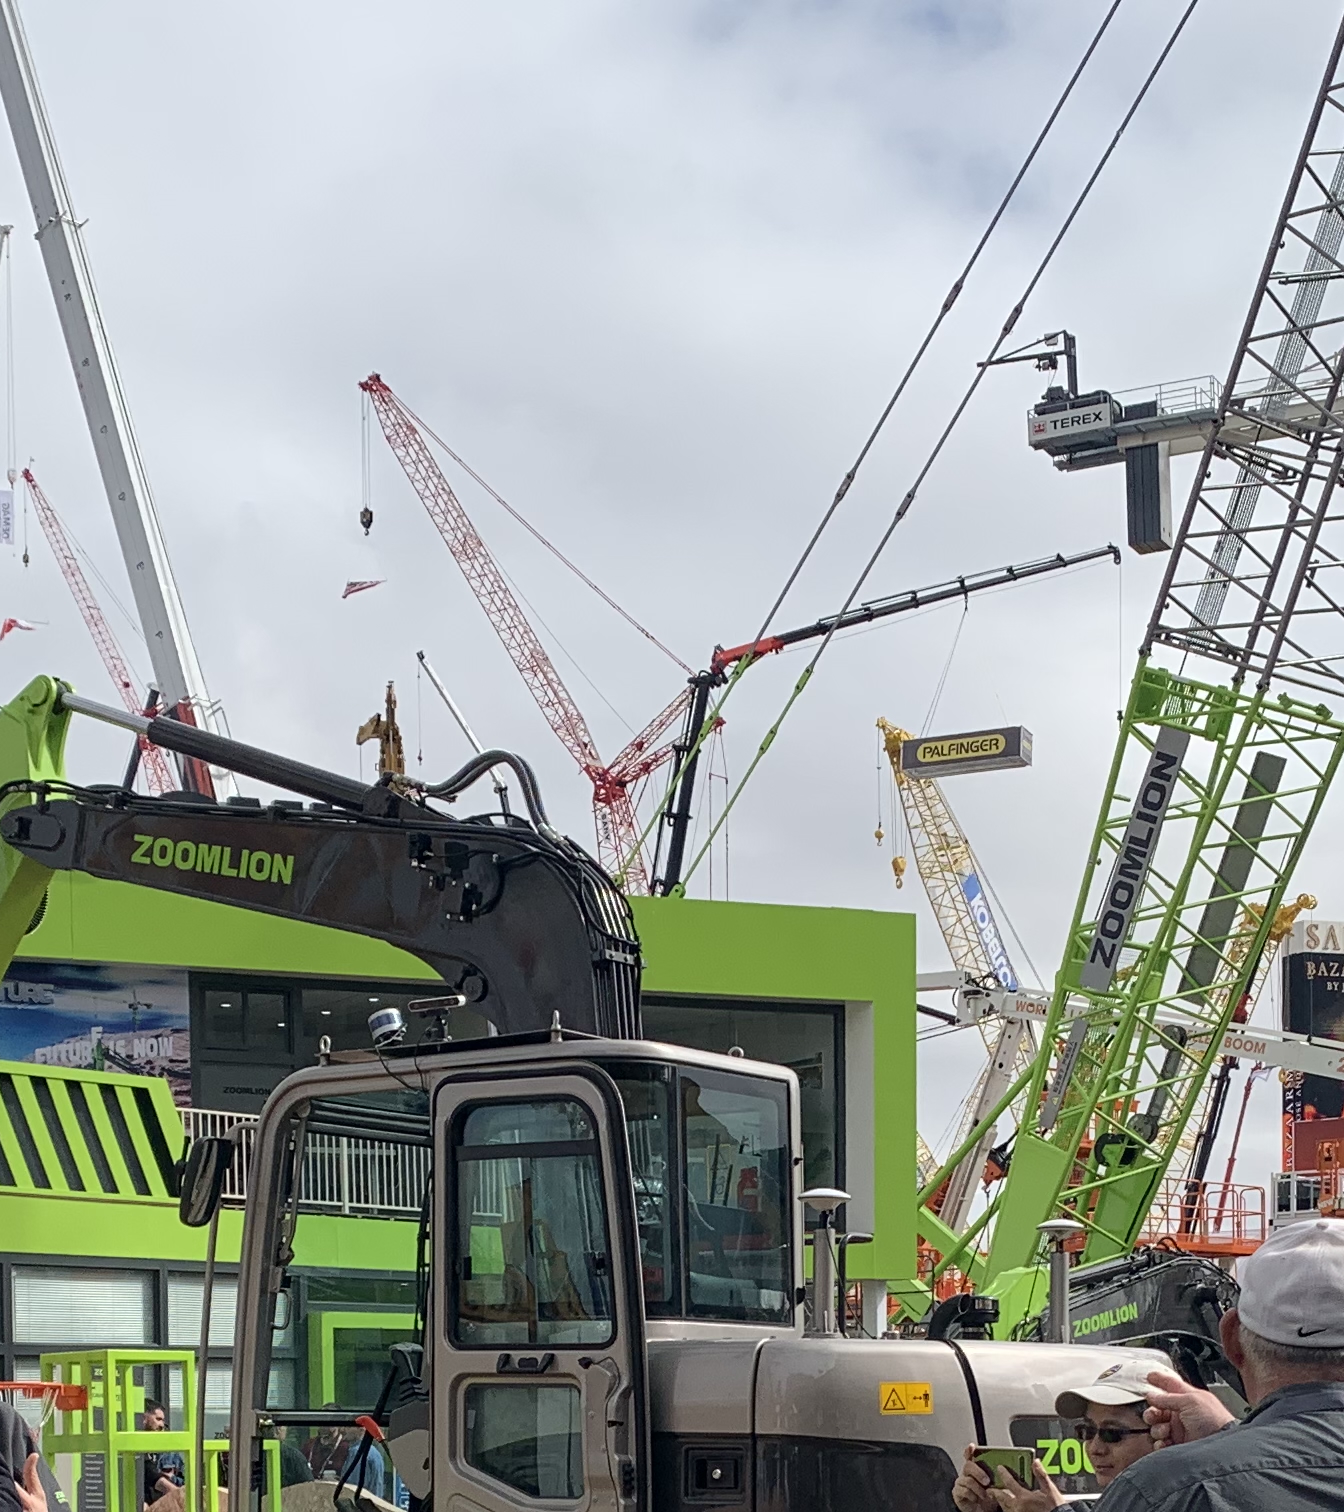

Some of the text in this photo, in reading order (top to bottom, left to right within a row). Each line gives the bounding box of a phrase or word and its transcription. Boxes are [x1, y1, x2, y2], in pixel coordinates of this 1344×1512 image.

[1049, 410, 1103, 430] TEREX
[922, 737, 1000, 759] PALFINGER
[131, 834, 295, 885] ZOOMLION
[1089, 750, 1178, 970] ZOOMLION
[970, 892, 1013, 988] KOBELCO
[1327, 981, 1340, 991] BY
[133, 1036, 174, 1059] NOW
[1223, 1037, 1268, 1055] BOOM
[1072, 1302, 1138, 1338] ZOOMLION
